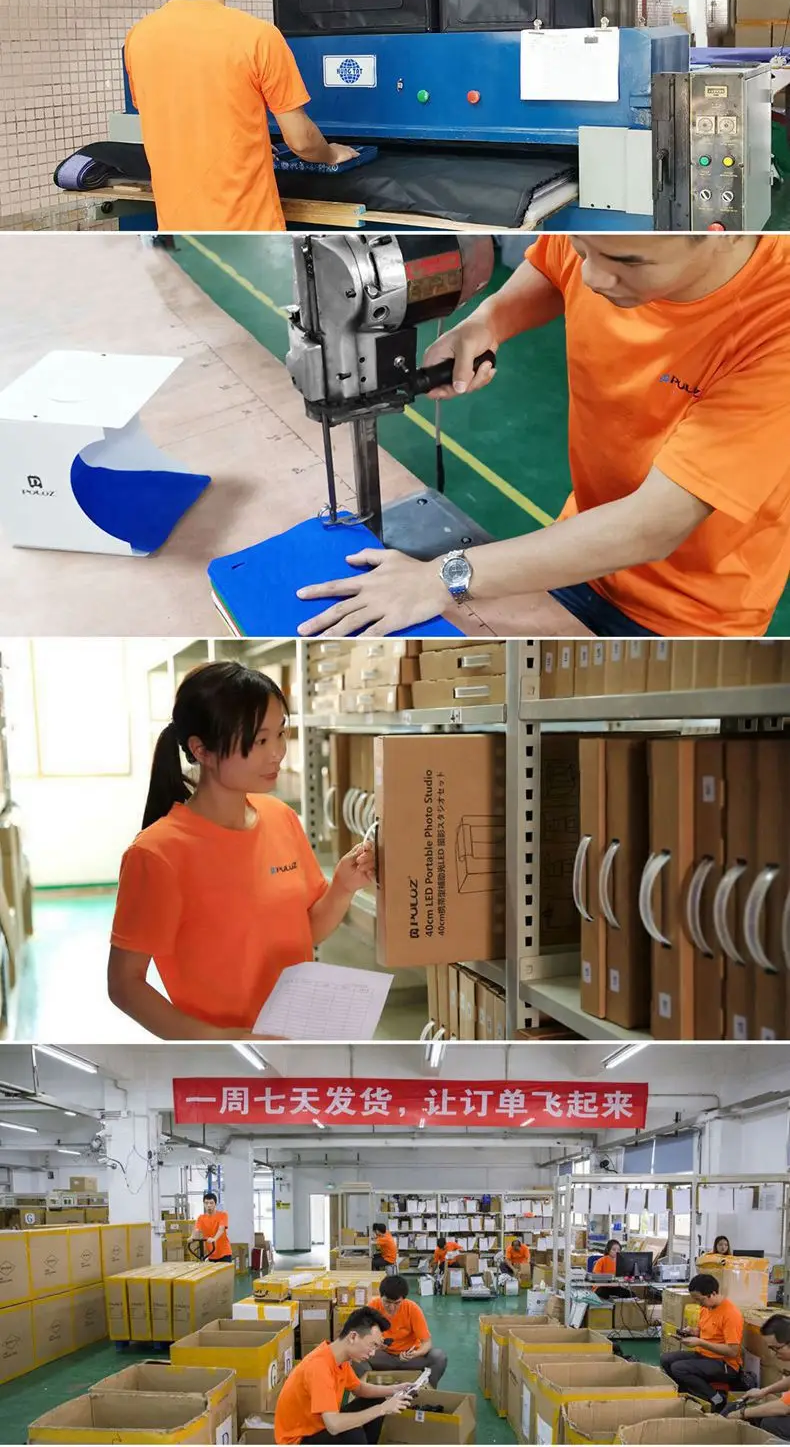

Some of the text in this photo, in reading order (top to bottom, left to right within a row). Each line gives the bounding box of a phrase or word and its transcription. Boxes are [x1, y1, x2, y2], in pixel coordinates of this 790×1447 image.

[409, 878, 419, 926] PULUZ
[423, 769, 433, 938] 40cm LED Portable Photo Studio
